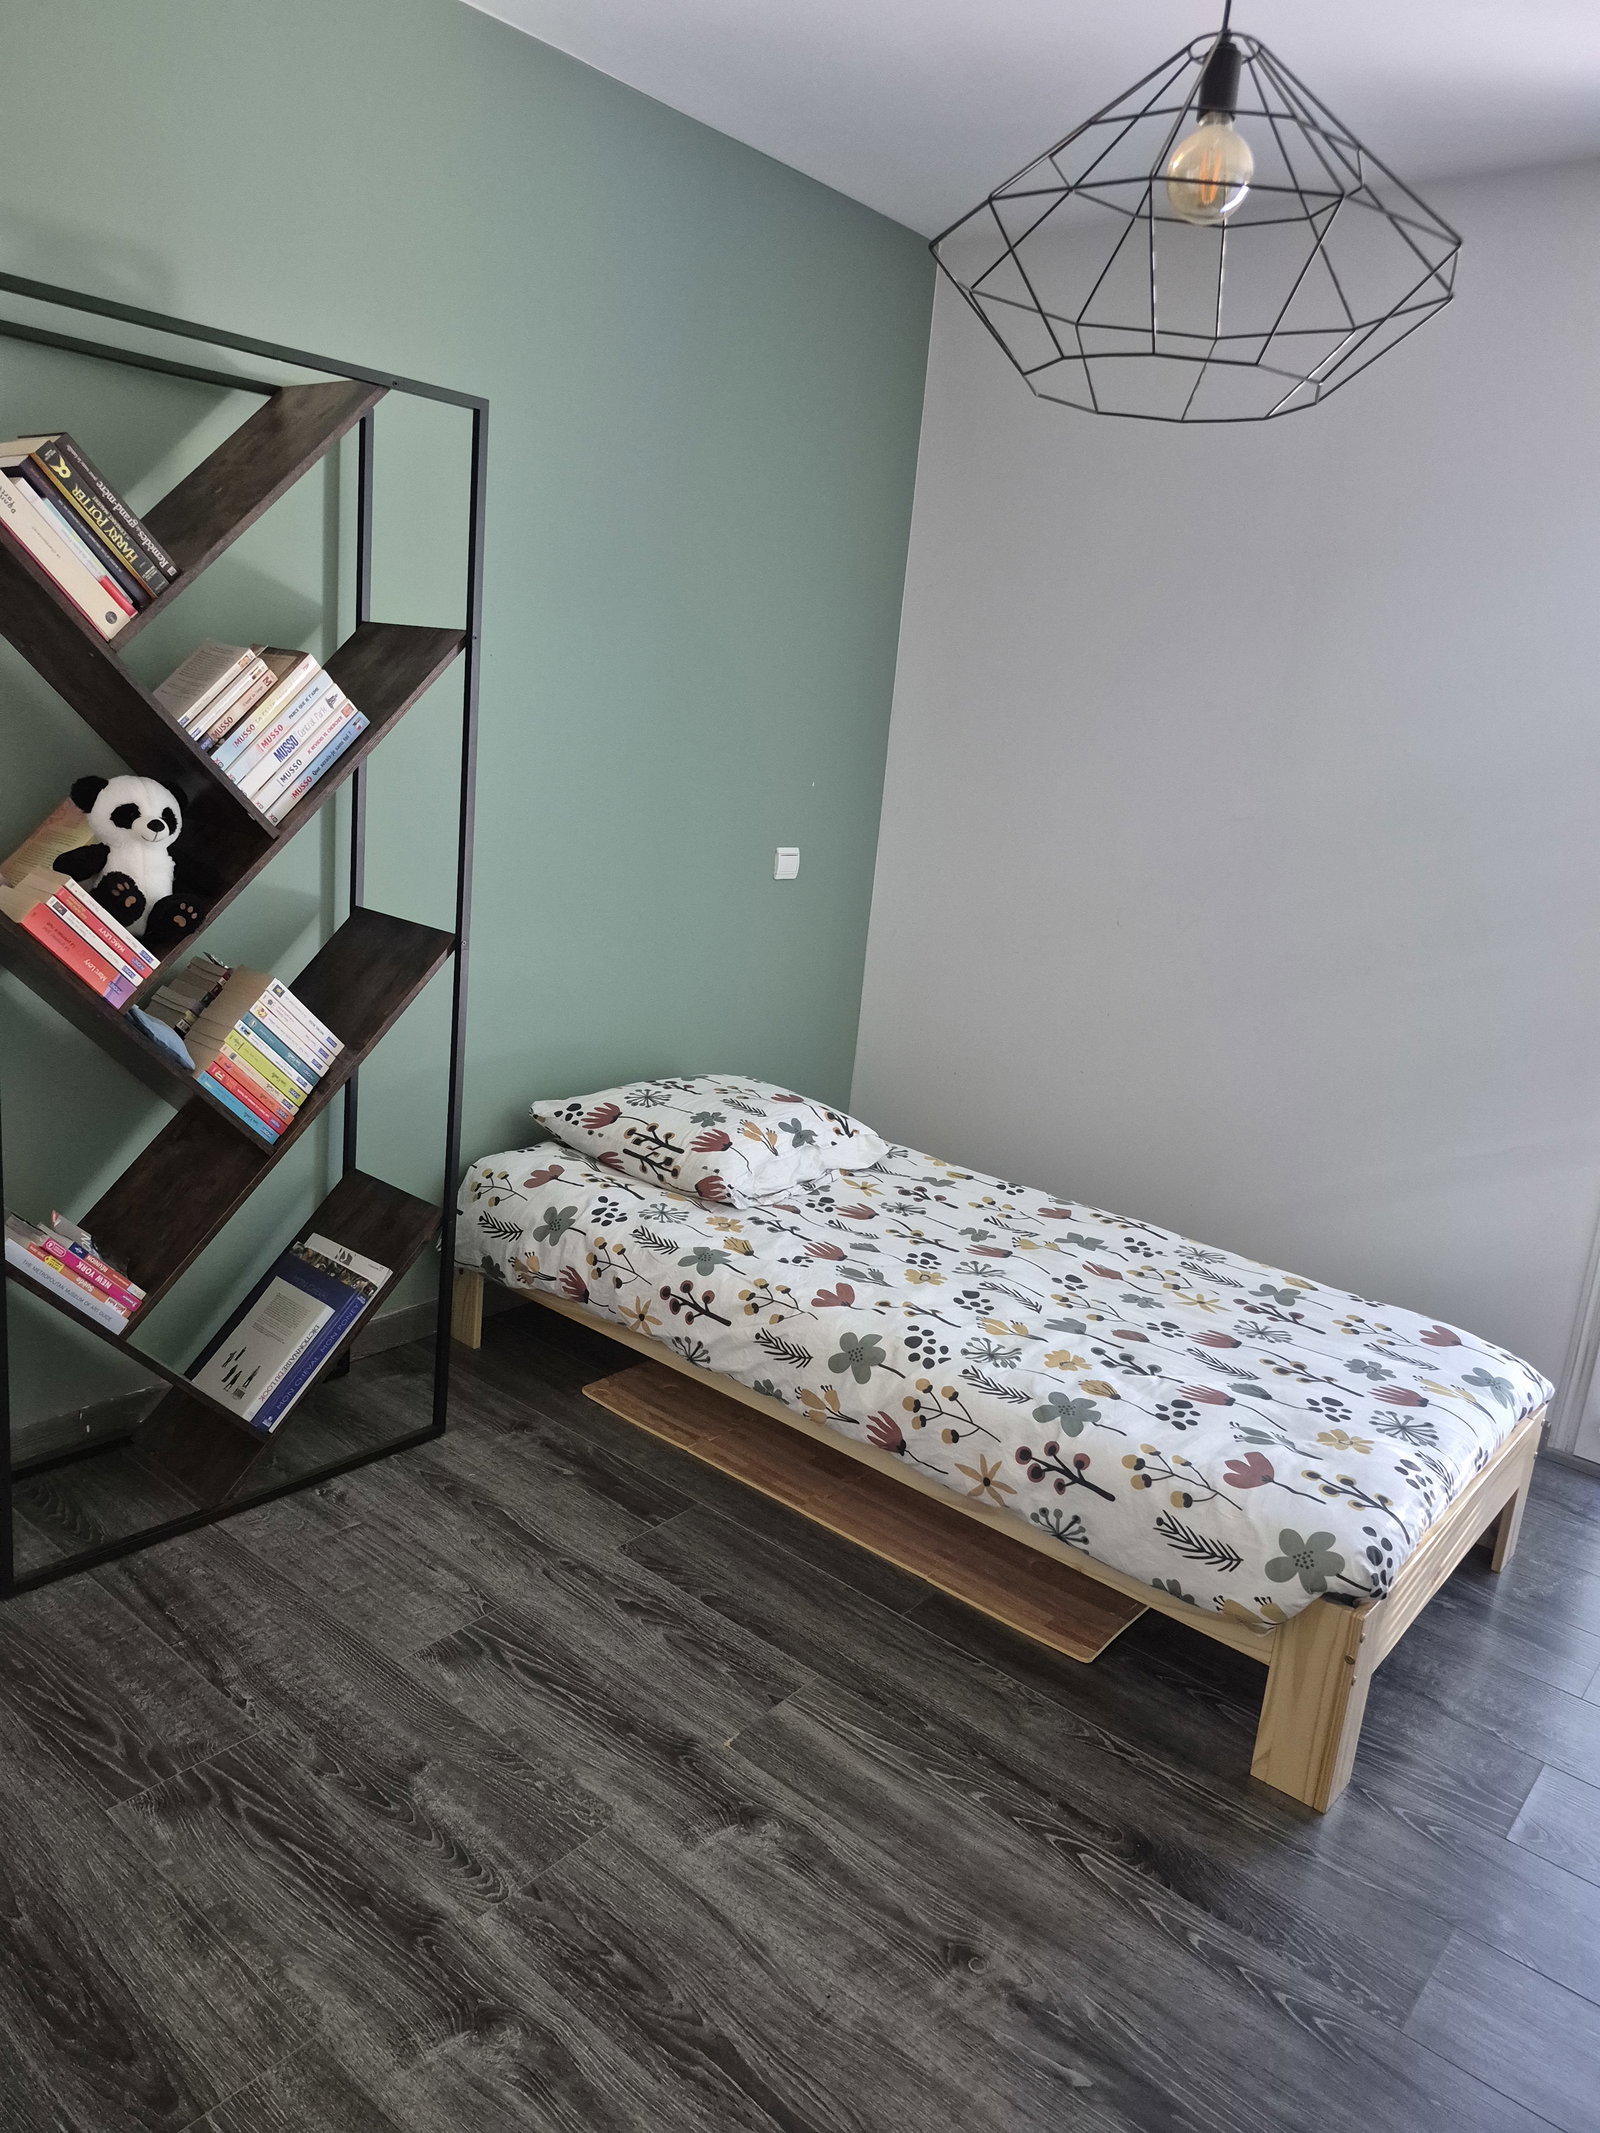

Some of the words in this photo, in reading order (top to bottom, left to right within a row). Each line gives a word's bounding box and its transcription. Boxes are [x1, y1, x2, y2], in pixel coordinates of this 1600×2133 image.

[68, 483, 109, 527] POTTER
[92, 479, 138, 530] grand-mère
[102, 523, 139, 563] HARRY
[134, 530, 169, 568] Remèdes
[209, 715, 235, 739] MUSSO
[232, 723, 257, 746] MUSSO
[259, 723, 285, 748] MUSSO
[271, 734, 300, 762] MUSSO
[278, 758, 304, 783] MUSSO
[289, 774, 314, 798] MUSSO
[310, 765, 322, 776] Que
[97, 926, 112, 940] LEVY
[109, 937, 126, 952] MARC
[81, 956, 97, 971] Levy
[93, 968, 107, 982] Marc
[75, 1260, 95, 1277] YORK
[85, 1254, 109, 1273] RÉUNION
[22, 1259, 32, 1268] THE
[31, 1265, 65, 1290] METROPOLITAN
[63, 1286, 84, 1303] MUSEUM
[74, 1276, 94, 1292] Suède
[94, 1273, 112, 1289] NEW
[275, 1387, 295, 1410] MON
[292, 1355, 319, 1387] CHEVAL
[318, 1331, 337, 1353] MON
[335, 1302, 360, 1331] PONEY
[280, 1323, 320, 1372] DICTIONNAIRE
[273, 1369, 284, 1382] DU
[257, 1380, 276, 1402] LOOK
